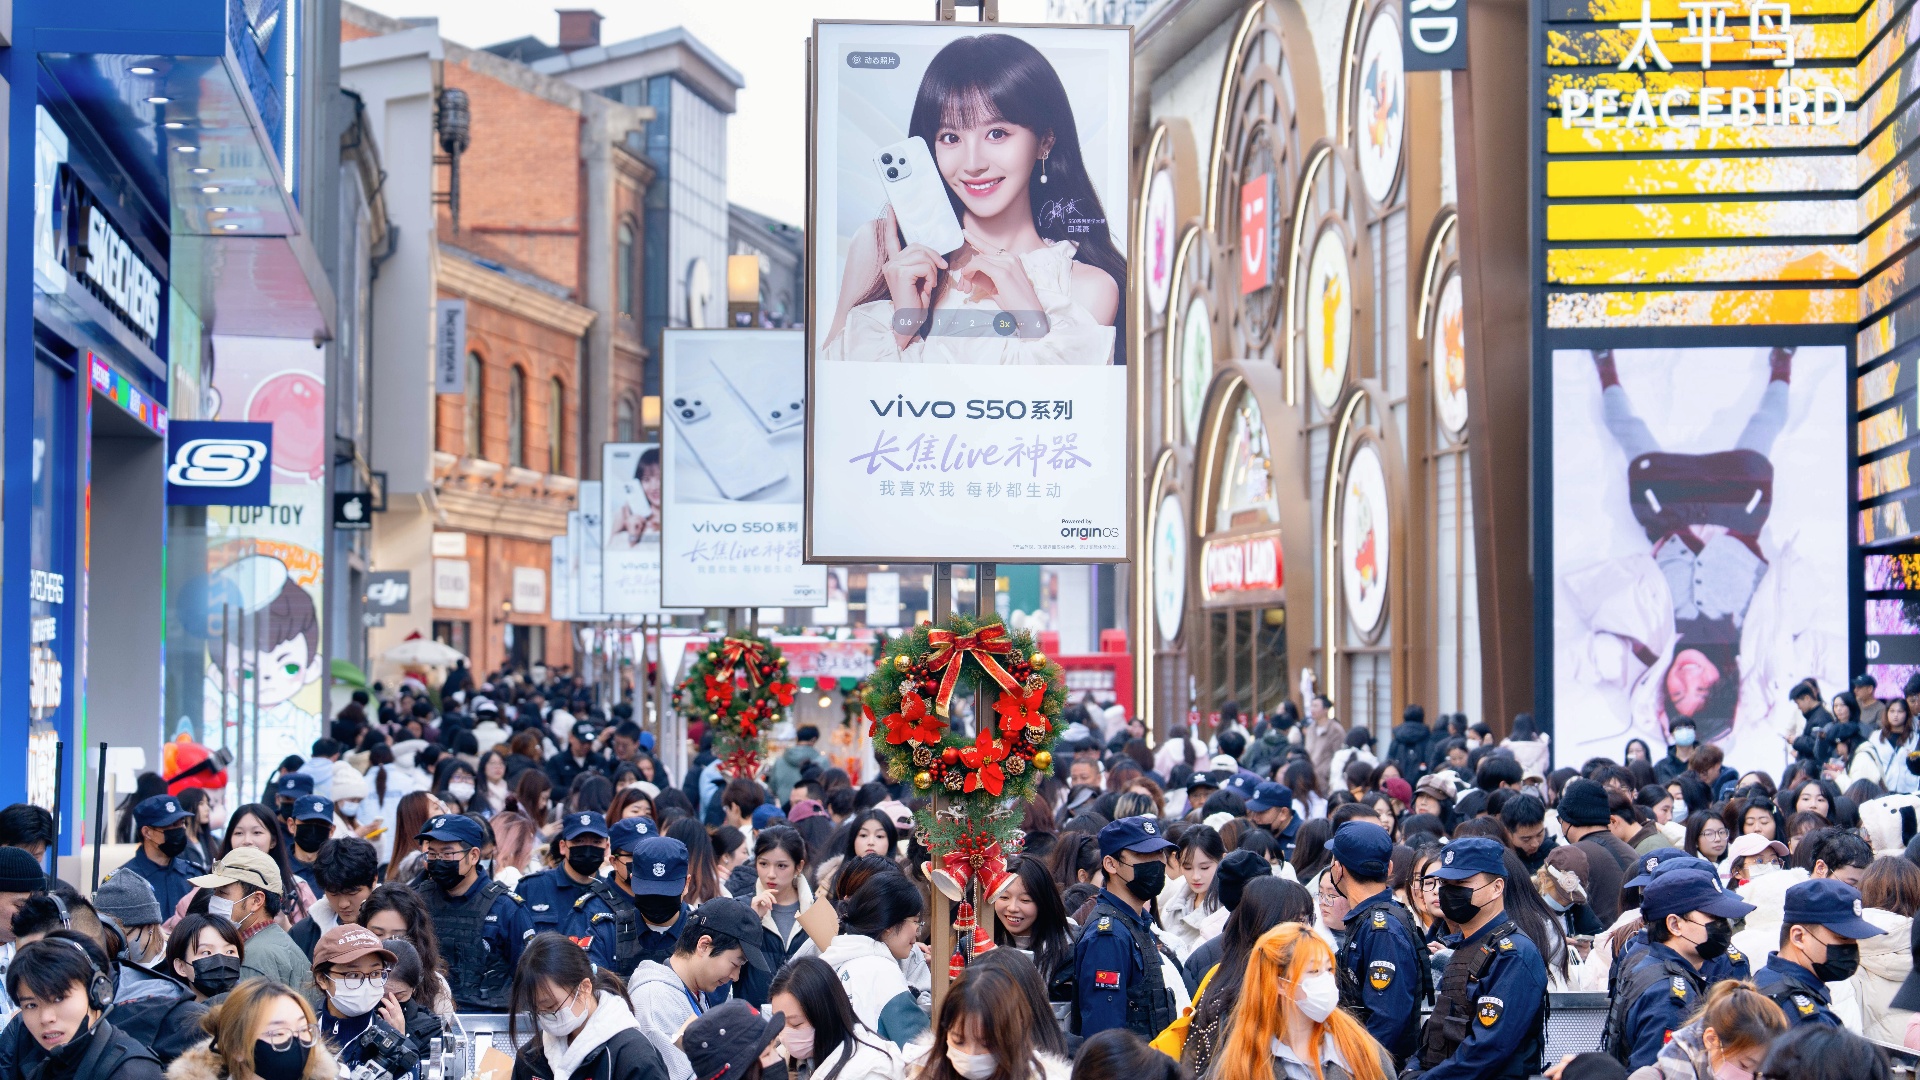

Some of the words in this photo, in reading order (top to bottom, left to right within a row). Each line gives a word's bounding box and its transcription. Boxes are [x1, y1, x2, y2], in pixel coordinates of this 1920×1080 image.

[1617, 0, 1795, 70] 太平鸟
[864, 56, 896, 65] 动态照片
[1560, 84, 1847, 129] PEACEBIRD
[85, 205, 161, 340] SKECHERS
[900, 318, 912, 326] 0.6
[937, 318, 942, 326] 1
[969, 319, 975, 327] 2
[999, 320, 1011, 328] 3x
[870, 394, 956, 419] vivo
[849, 429, 1092, 478] 长焦live神器
[879, 480, 955, 498] 我喜欢我
[966, 481, 1062, 499] 每秒都生动
[271, 505, 303, 525] TOY
[692, 520, 737, 533] vivo
